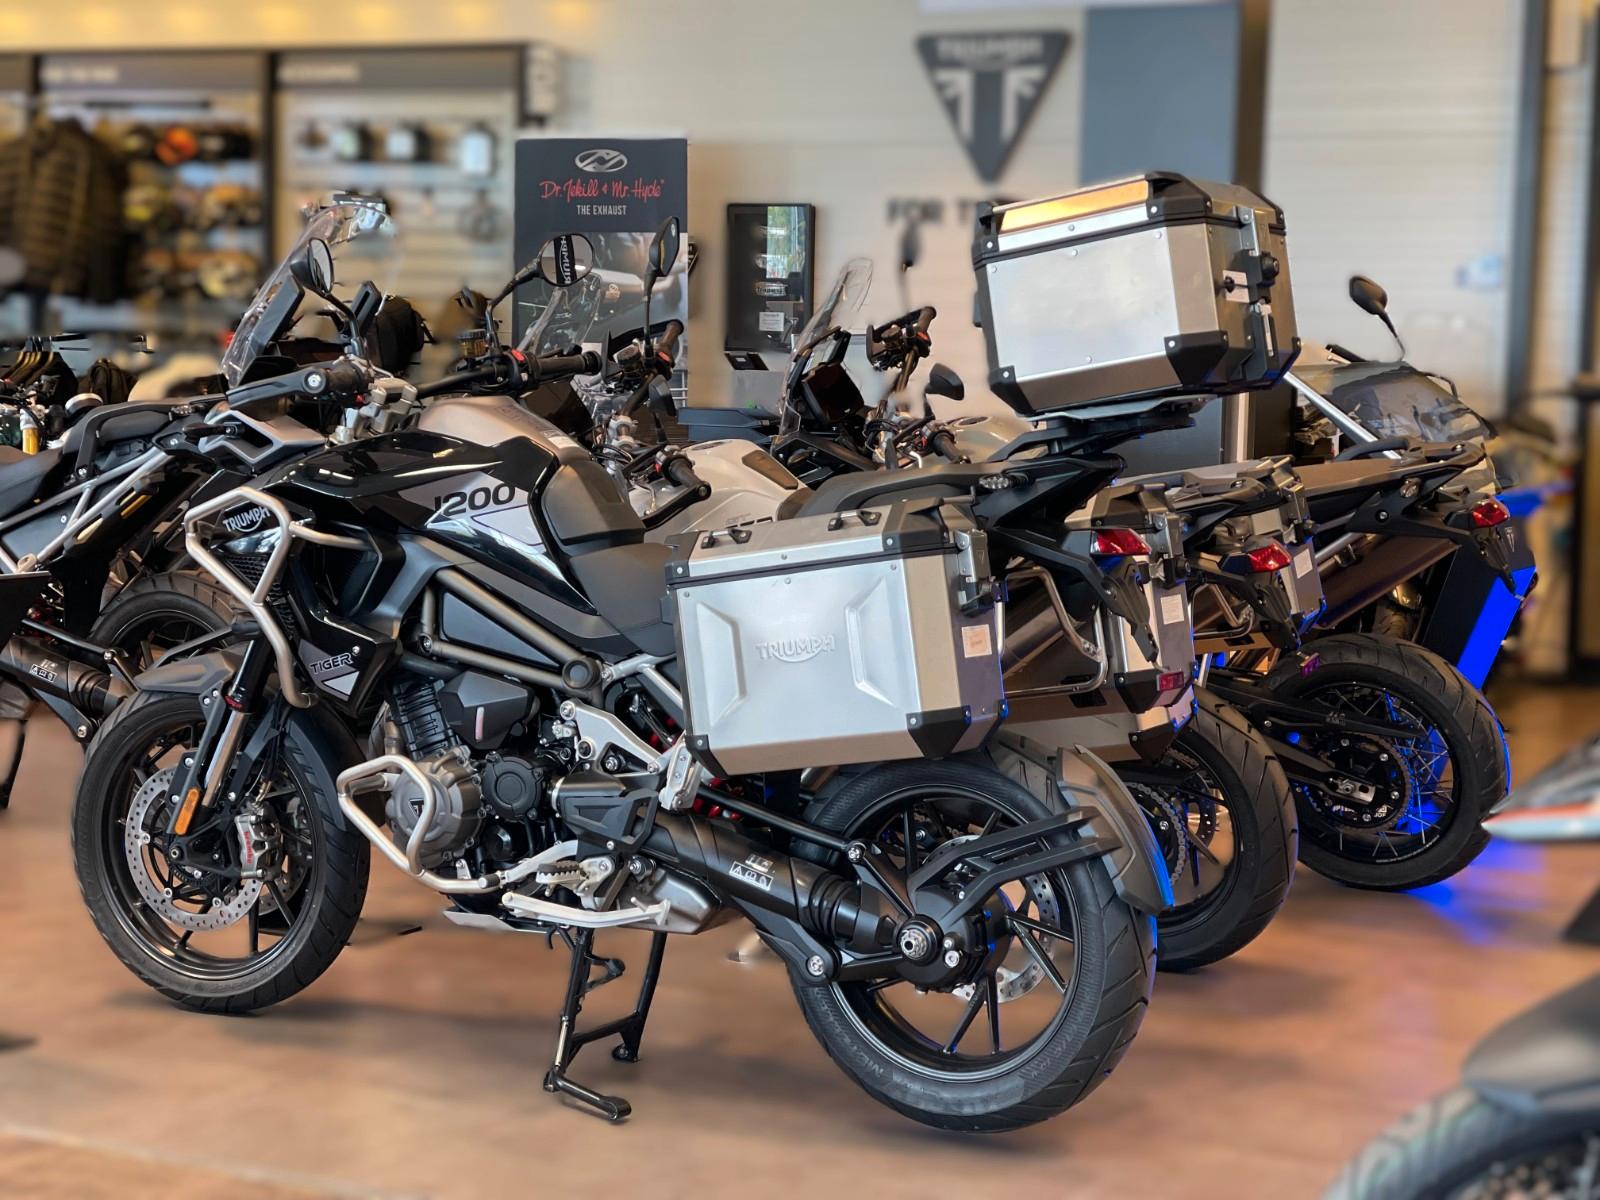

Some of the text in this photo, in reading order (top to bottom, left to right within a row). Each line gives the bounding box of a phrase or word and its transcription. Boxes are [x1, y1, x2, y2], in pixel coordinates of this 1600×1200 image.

[539, 180, 563, 199] Dr.
[611, 181, 630, 199] Mr.
[576, 204, 627, 216] THE EXHAUST
[434, 483, 516, 517] 1200
[222, 505, 271, 533] TRIUMPH
[754, 634, 835, 662] TRIUMPH
[309, 652, 354, 675] TIGER
